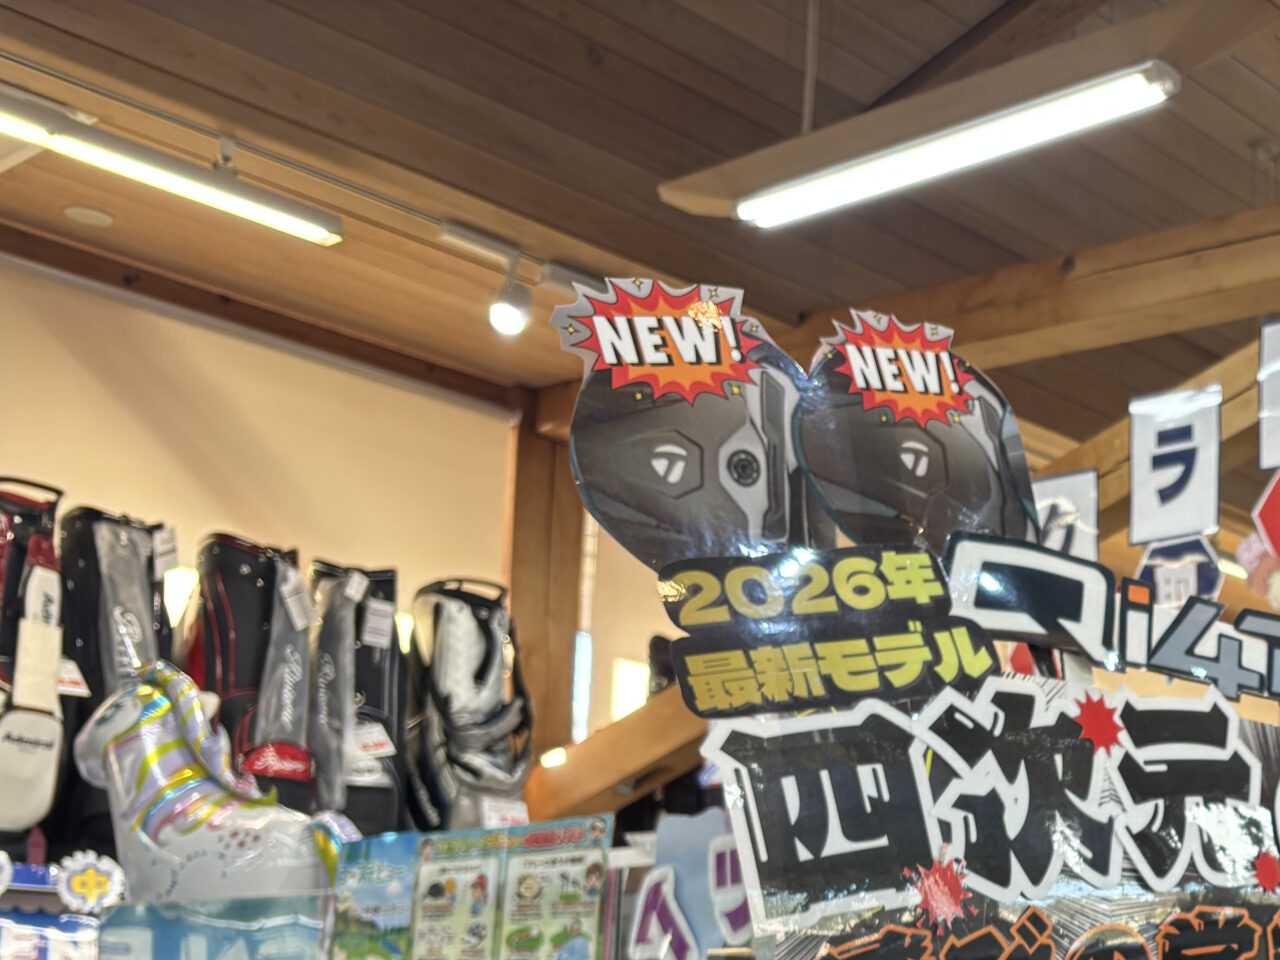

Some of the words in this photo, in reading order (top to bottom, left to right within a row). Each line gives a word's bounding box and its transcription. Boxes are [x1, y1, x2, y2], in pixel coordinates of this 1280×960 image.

[592, 314, 744, 367] NEW!
[849, 343, 962, 395] NEW!
[676, 550, 945, 628] 2026年
[684, 620, 996, 713] 最新モデル
